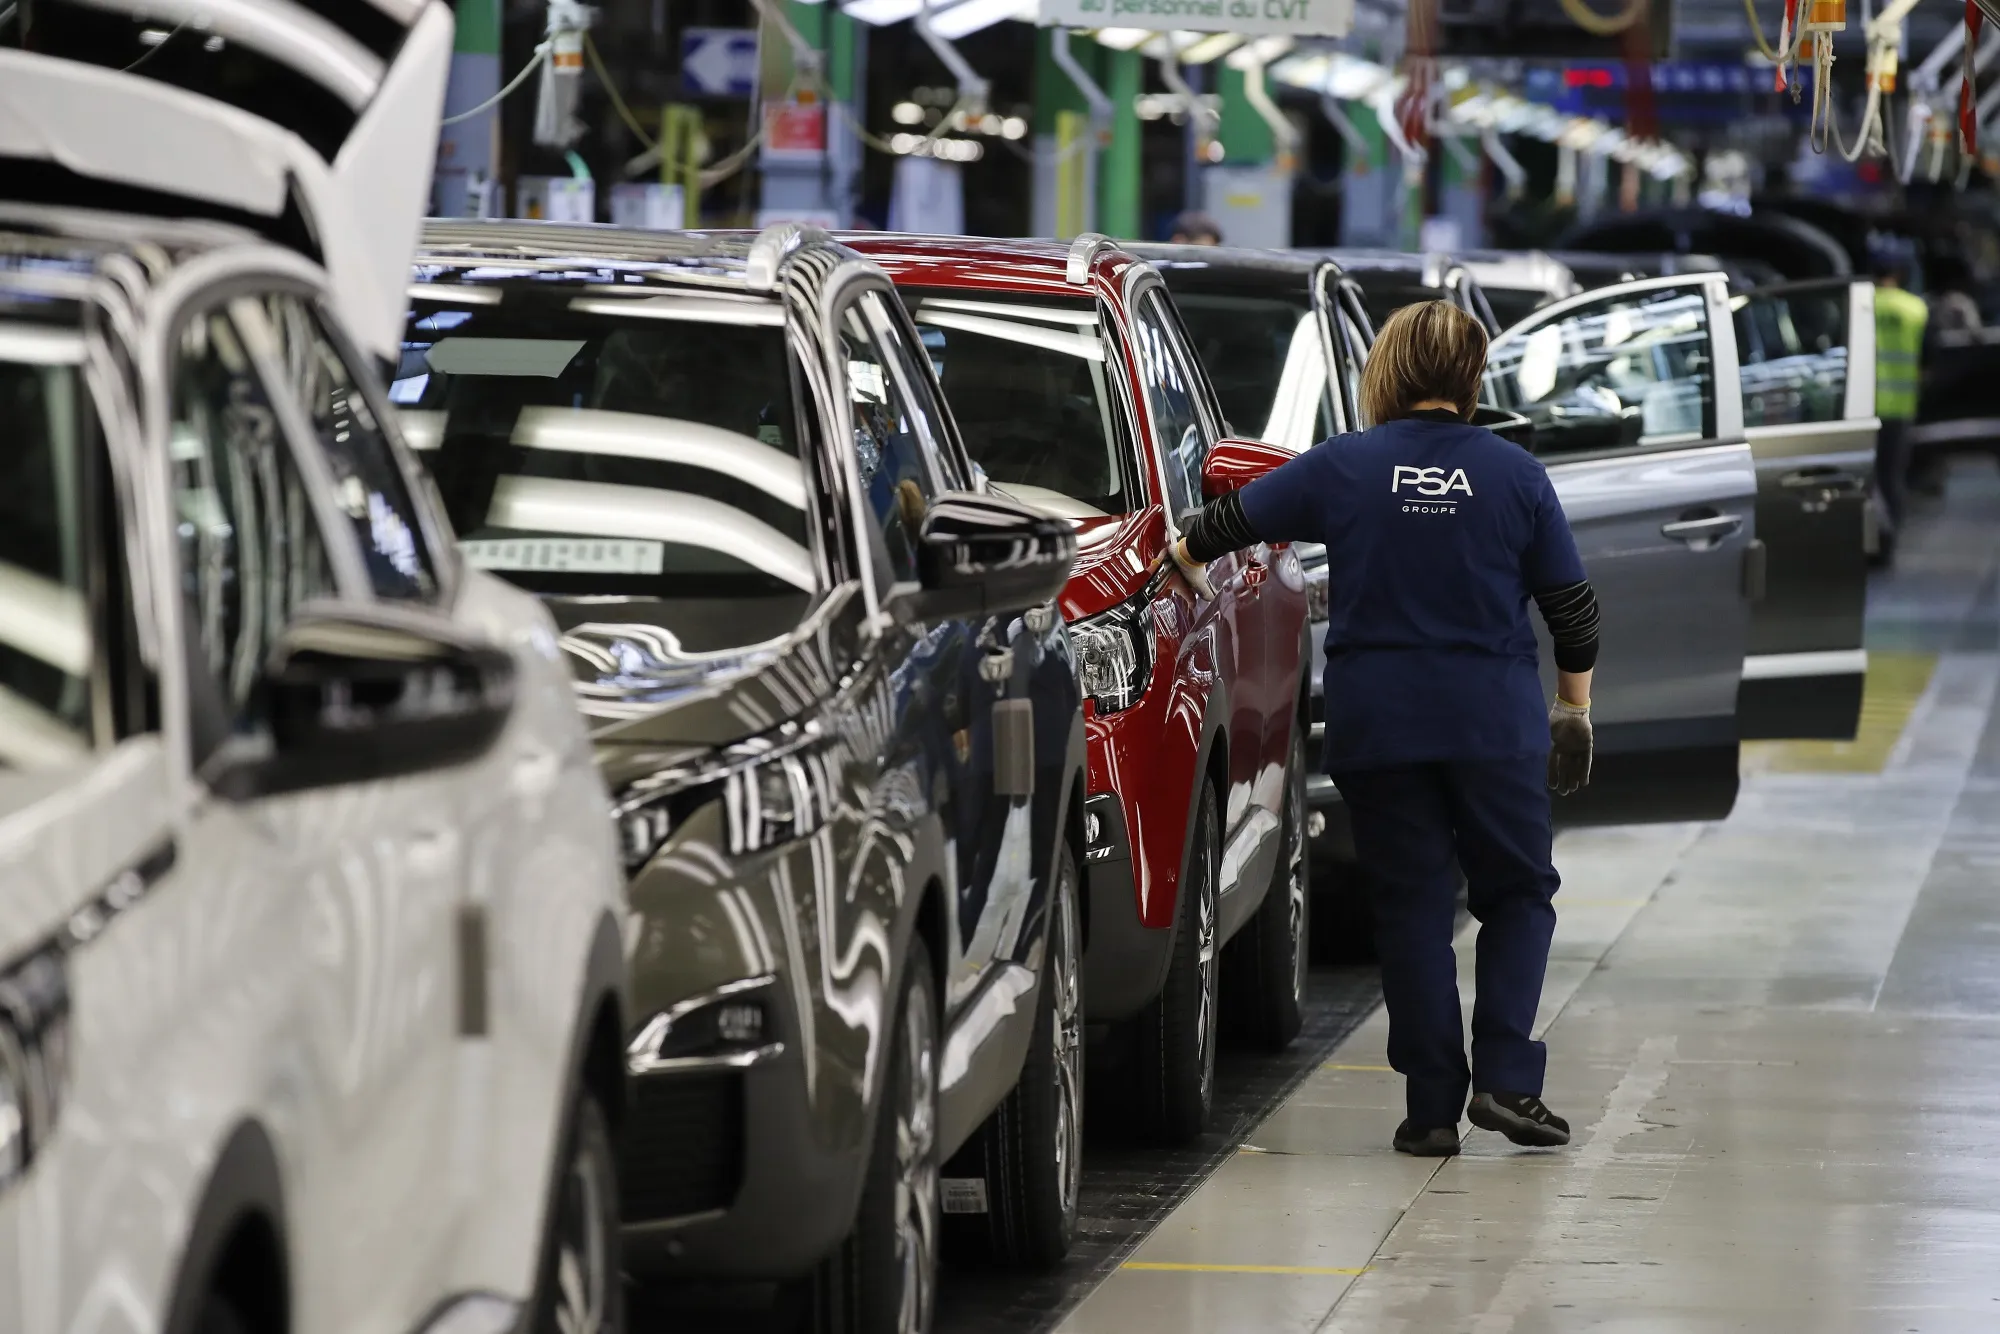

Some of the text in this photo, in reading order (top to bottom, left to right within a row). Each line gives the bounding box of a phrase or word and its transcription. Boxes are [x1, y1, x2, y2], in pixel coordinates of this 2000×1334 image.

[1111, 0, 1223, 19] personnel
[1230, 0, 1258, 18] du
[1263, 0, 1311, 21] CVT
[1392, 465, 1473, 496] PSA
[1402, 505, 1457, 515] GROUPE
